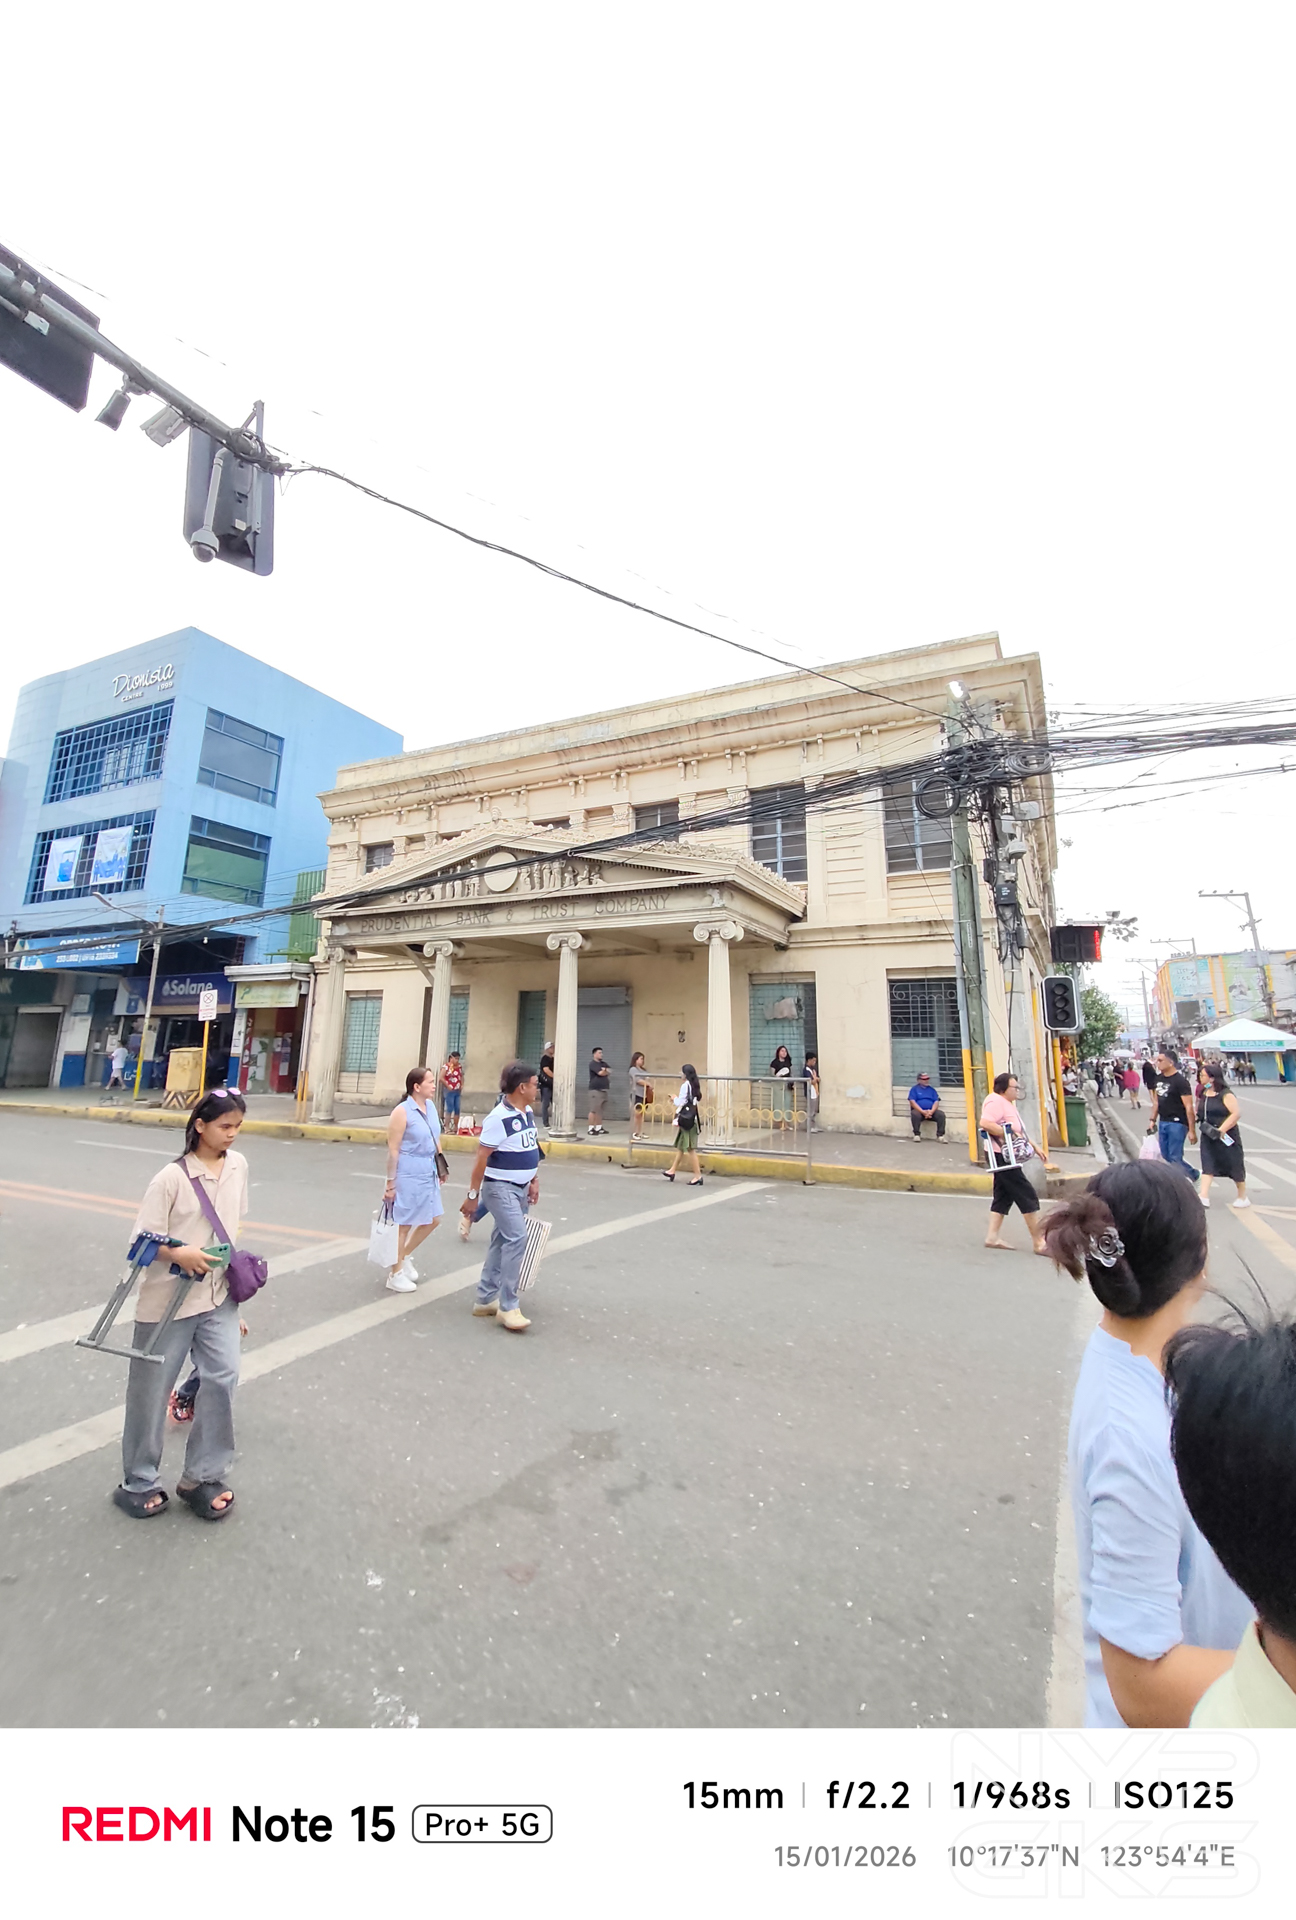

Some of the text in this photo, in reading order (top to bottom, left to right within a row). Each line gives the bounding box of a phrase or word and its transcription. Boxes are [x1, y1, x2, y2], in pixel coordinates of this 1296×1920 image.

[112, 663, 175, 698] Dionisia
[361, 893, 670, 933] PRUDENTIAL BANK & TRUST COMPANY
[169, 977, 213, 996] Solane
[1225, 1040, 1280, 1048] ENTRANCE
